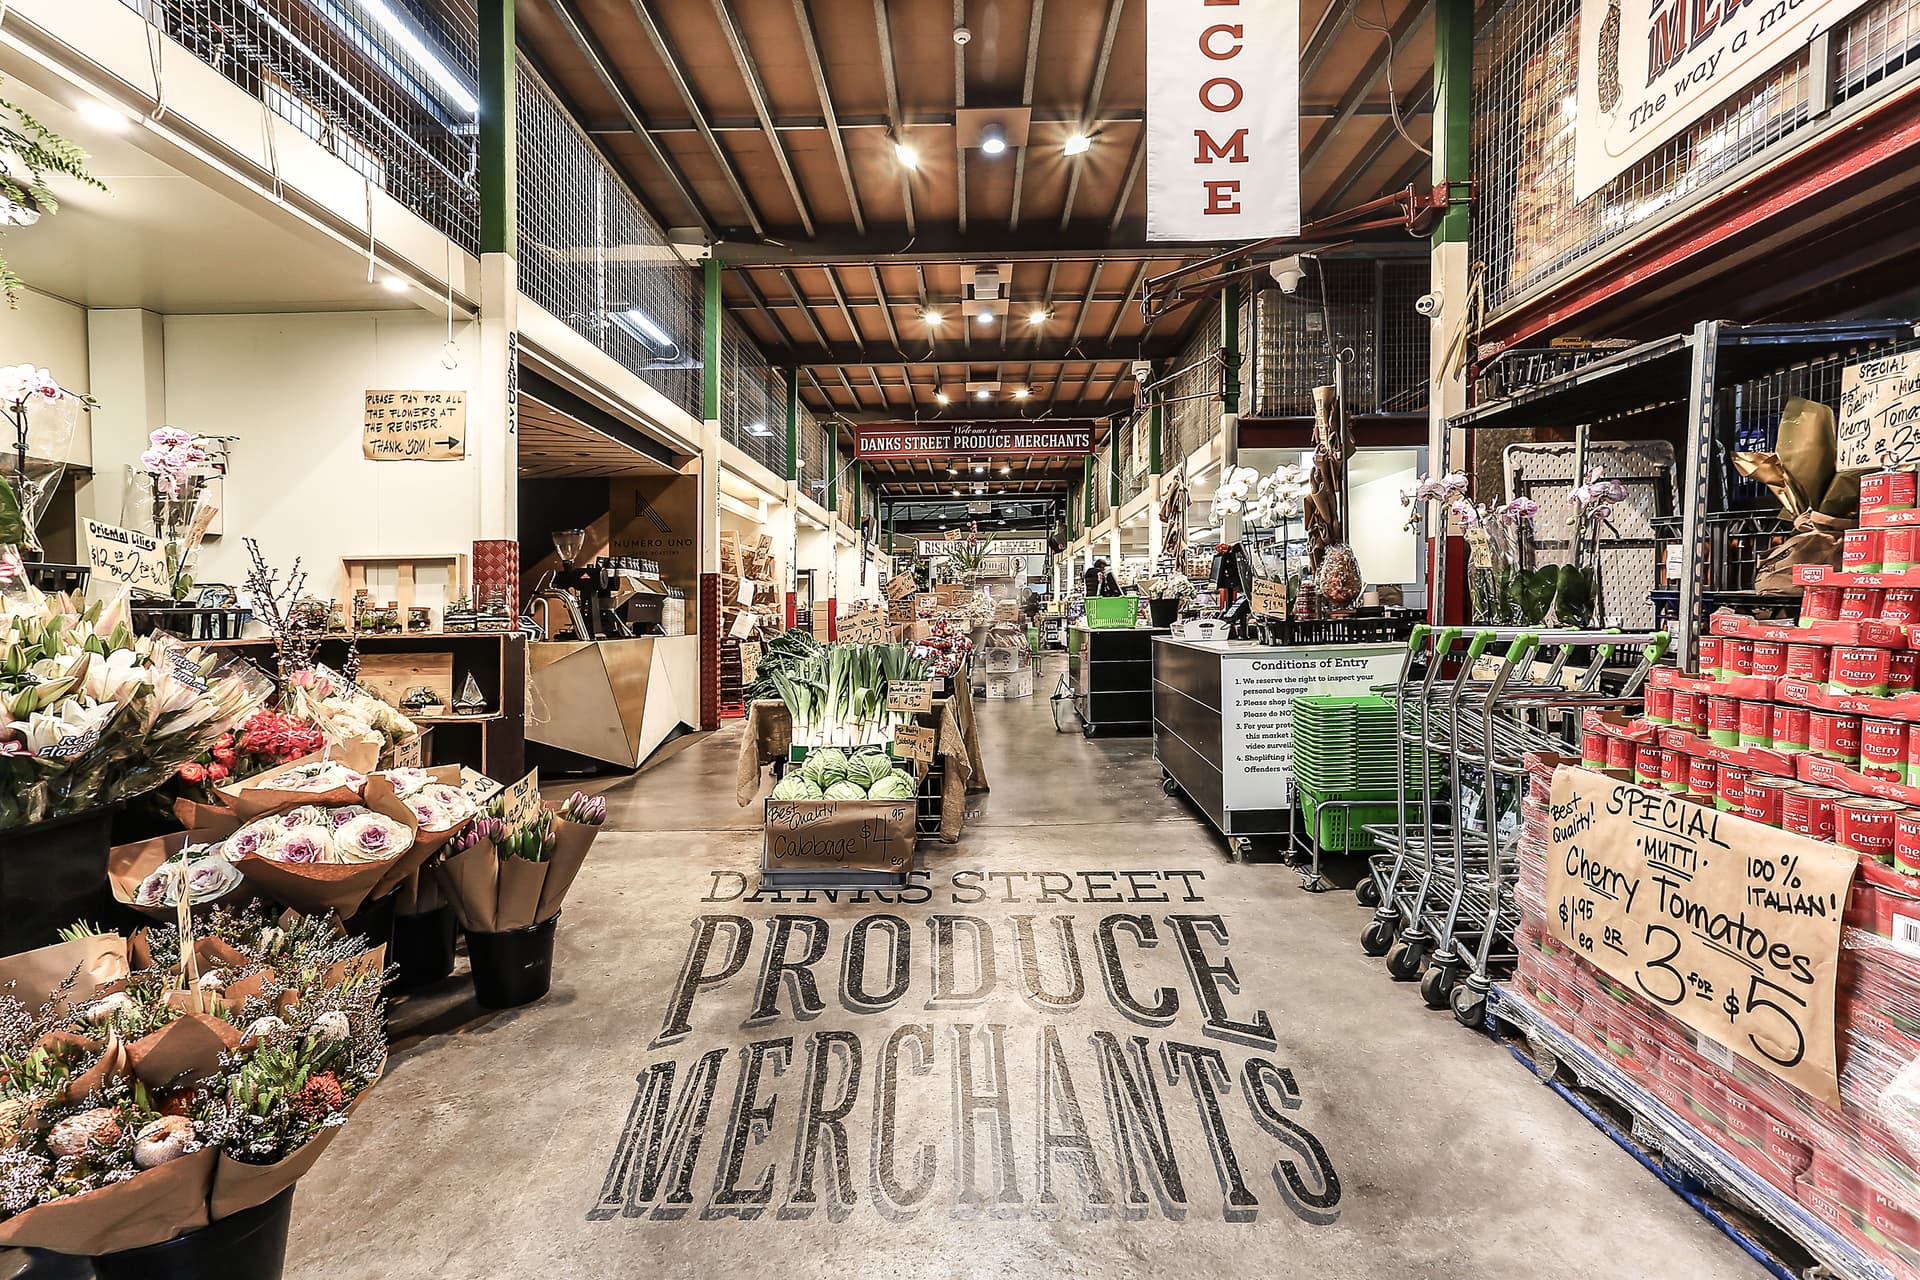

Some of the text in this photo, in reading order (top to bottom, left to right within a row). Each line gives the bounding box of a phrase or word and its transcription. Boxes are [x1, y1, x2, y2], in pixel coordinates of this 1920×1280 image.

[1629, 92, 1667, 133] The
[1674, 46, 1725, 97] way
[1731, 29, 1748, 53] a
[1194, 0, 1249, 215] COME
[1859, 356, 1909, 379] SPECIAL
[366, 394, 462, 404] PLEASE PAY FOR ALL
[366, 408, 456, 418] THE FLOWERS AT
[365, 423, 383, 433] THE
[1840, 402, 1920, 440] Cherry Toma
[952, 424, 998, 434] Welcome to
[370, 439, 404, 454] THANK
[860, 433, 1090, 451] DANKS STREET PRODUCE MERCHANTS
[614, 538, 693, 548] NUMERO UNO
[1252, 658, 1369, 670] Conditions of Entry
[1842, 653, 1878, 661] MUTTI
[1298, 676, 1317, 684] right
[1327, 674, 1355, 683] inspect
[1840, 670, 1876, 680] Cherry
[1243, 686, 1308, 696] personal baggage
[1268, 698, 1286, 708] shop
[1865, 725, 1900, 736] MUTTI
[1864, 744, 1900, 757] Cherry
[1244, 754, 1285, 763] Shoplifting
[1690, 761, 1716, 772] MUTTI
[1690, 776, 1715, 788] Cherry
[768, 802, 800, 827] Best
[1551, 792, 1582, 822] Best
[789, 802, 839, 830] Quality!
[1552, 802, 1597, 845] Quality!
[1606, 785, 1731, 849] SPECIAL
[1850, 813, 1894, 824] MUTTI
[1850, 832, 1894, 846] Cherry
[774, 834, 857, 862] Cabbage
[890, 856, 904, 868] ea
[1898, 844, 1920, 857] Che
[1748, 854, 1802, 889] 100%
[951, 868, 1206, 904] STREET
[1746, 885, 1837, 922] ITALIAN!
[1566, 845, 1814, 986] Cherry Tomatoes
[1578, 930, 1594, 952] ea
[646, 911, 1278, 1052] PRODUCE
[1604, 926, 1624, 946] OR
[1635, 924, 1686, 1007] 3
[1724, 974, 1807, 1067] $5
[585, 1021, 1344, 1230] MERCHANTS
